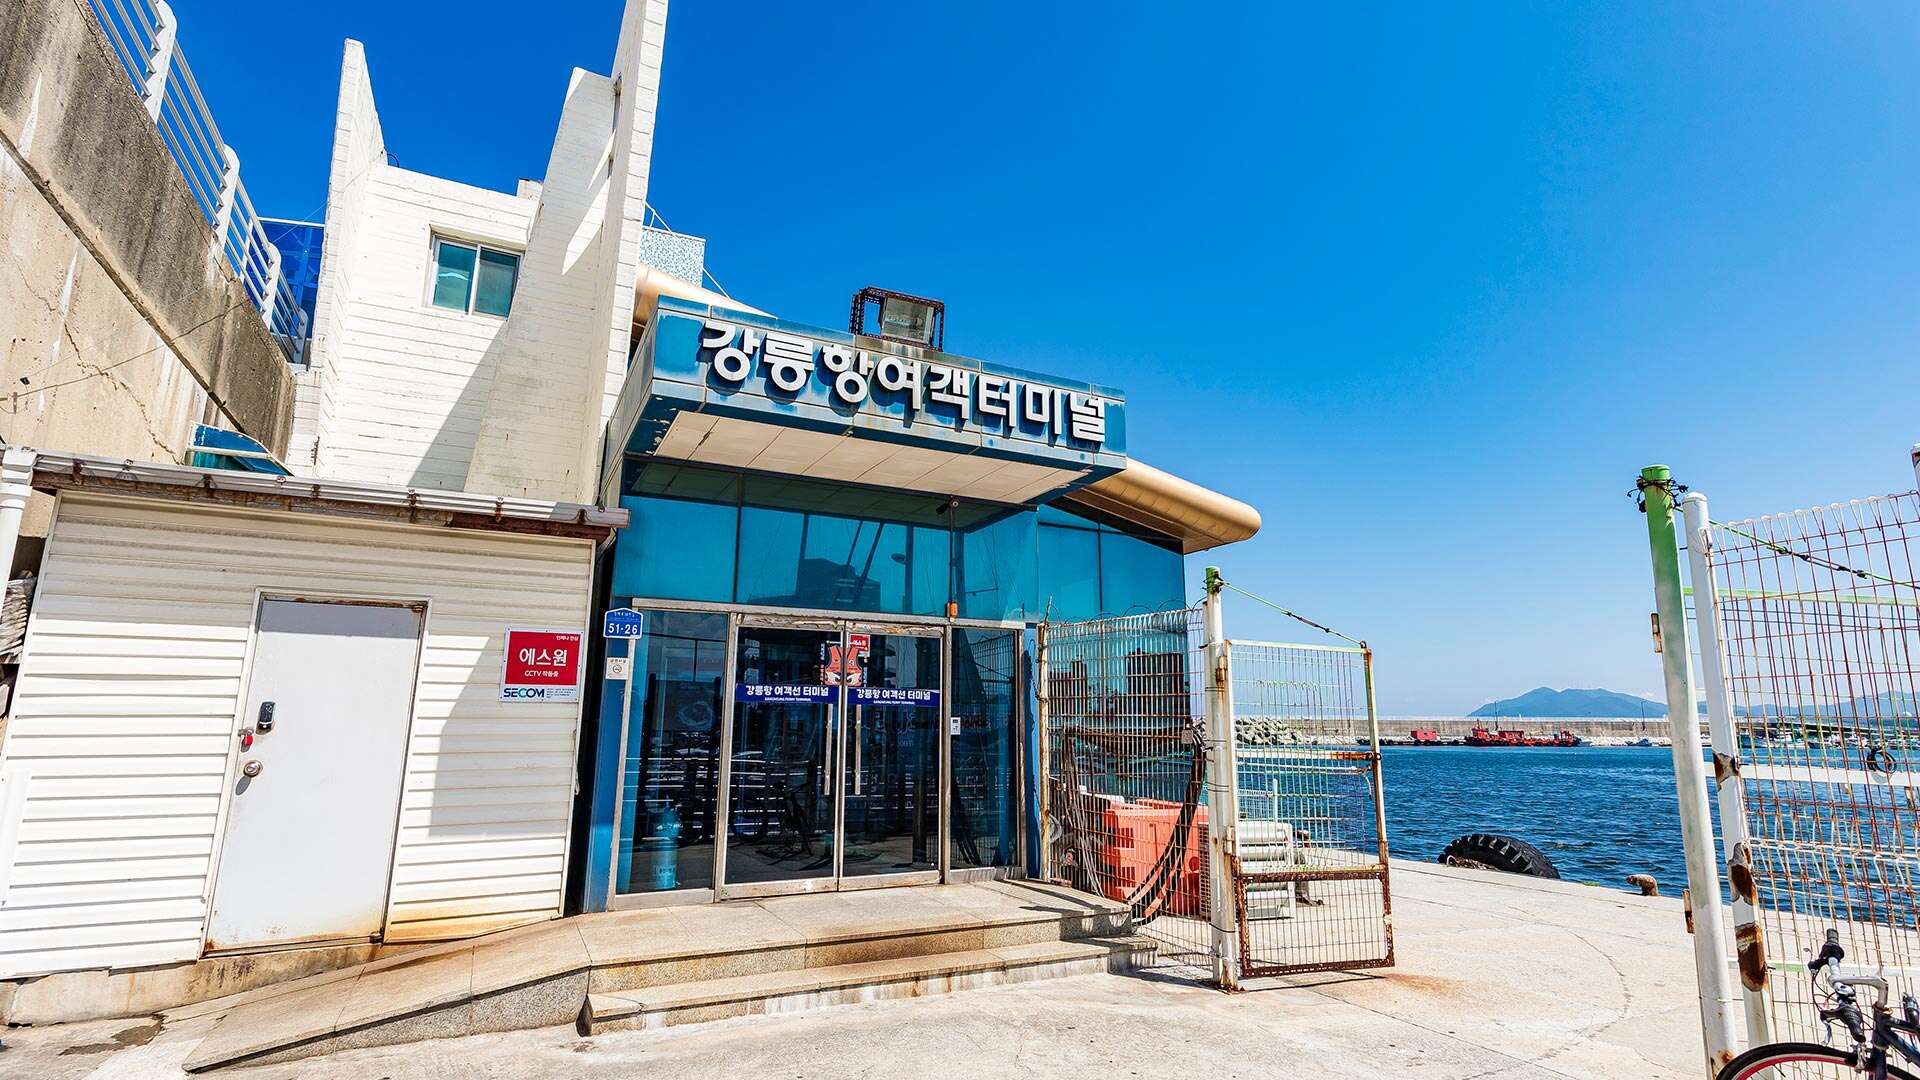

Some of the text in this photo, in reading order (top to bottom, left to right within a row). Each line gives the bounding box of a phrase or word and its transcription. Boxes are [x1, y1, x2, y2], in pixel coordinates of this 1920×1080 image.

[702, 319, 1106, 442] 강릉항여객터미널
[608, 623, 638, 634] 51-26
[519, 647, 568, 667] 에스원
[503, 687, 545, 698] SECOM
[745, 685, 829, 697] 강릉항 여객선 터미널
[856, 688, 931, 701] 강릉항 여객선 터미널
